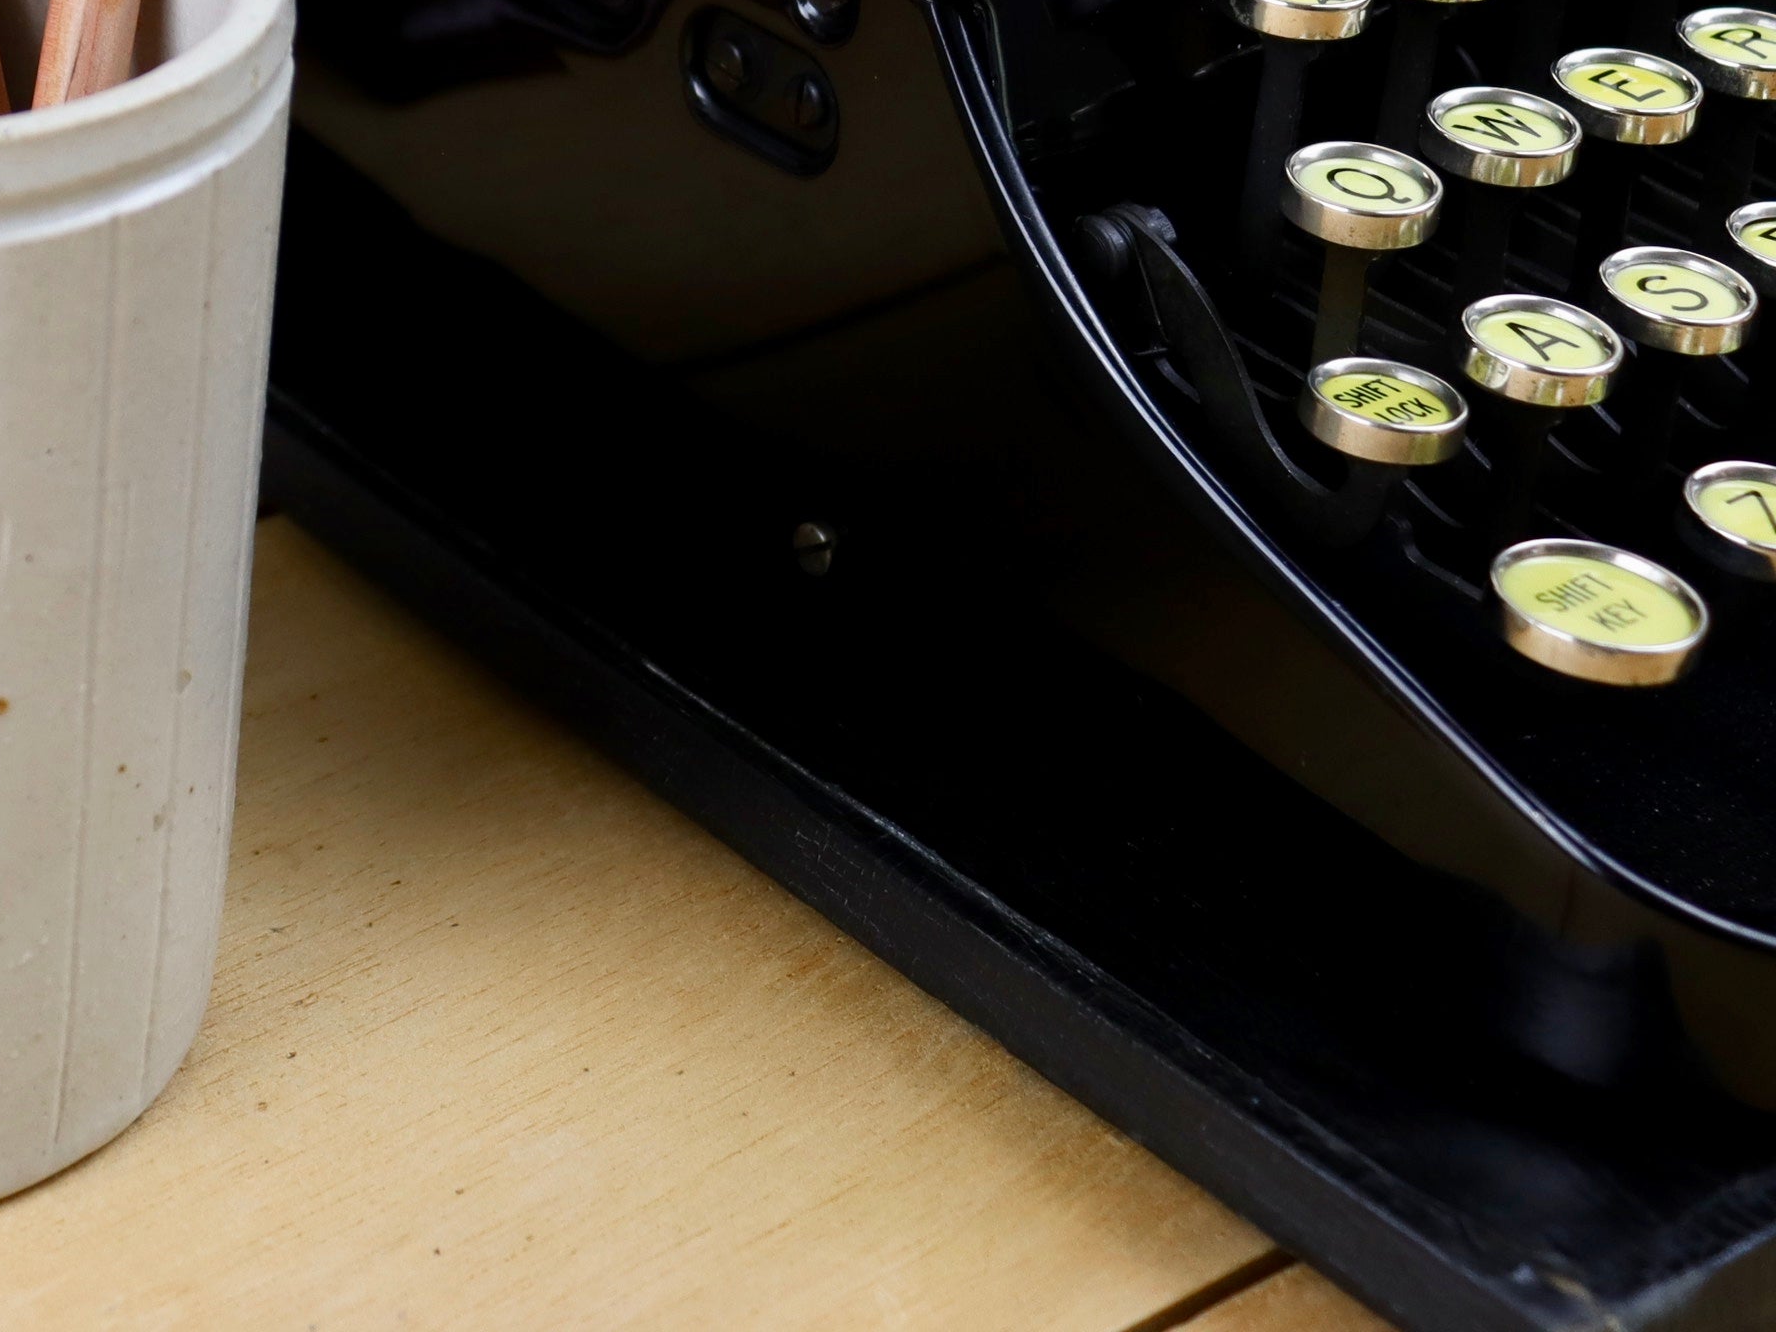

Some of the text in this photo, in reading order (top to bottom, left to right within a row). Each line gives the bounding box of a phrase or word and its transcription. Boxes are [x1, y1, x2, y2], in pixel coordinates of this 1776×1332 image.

[1710, 28, 1776, 60] R
[1588, 69, 1666, 103] E
[1453, 108, 1543, 147] W
[1326, 167, 1413, 203] Q
[1636, 275, 1709, 312] S
[1505, 321, 1581, 362] A
[1333, 378, 1402, 409] SHIFT
[1373, 397, 1441, 425] LOCK
[1535, 573, 1614, 613] SHIFT
[1588, 598, 1649, 633] KEY
